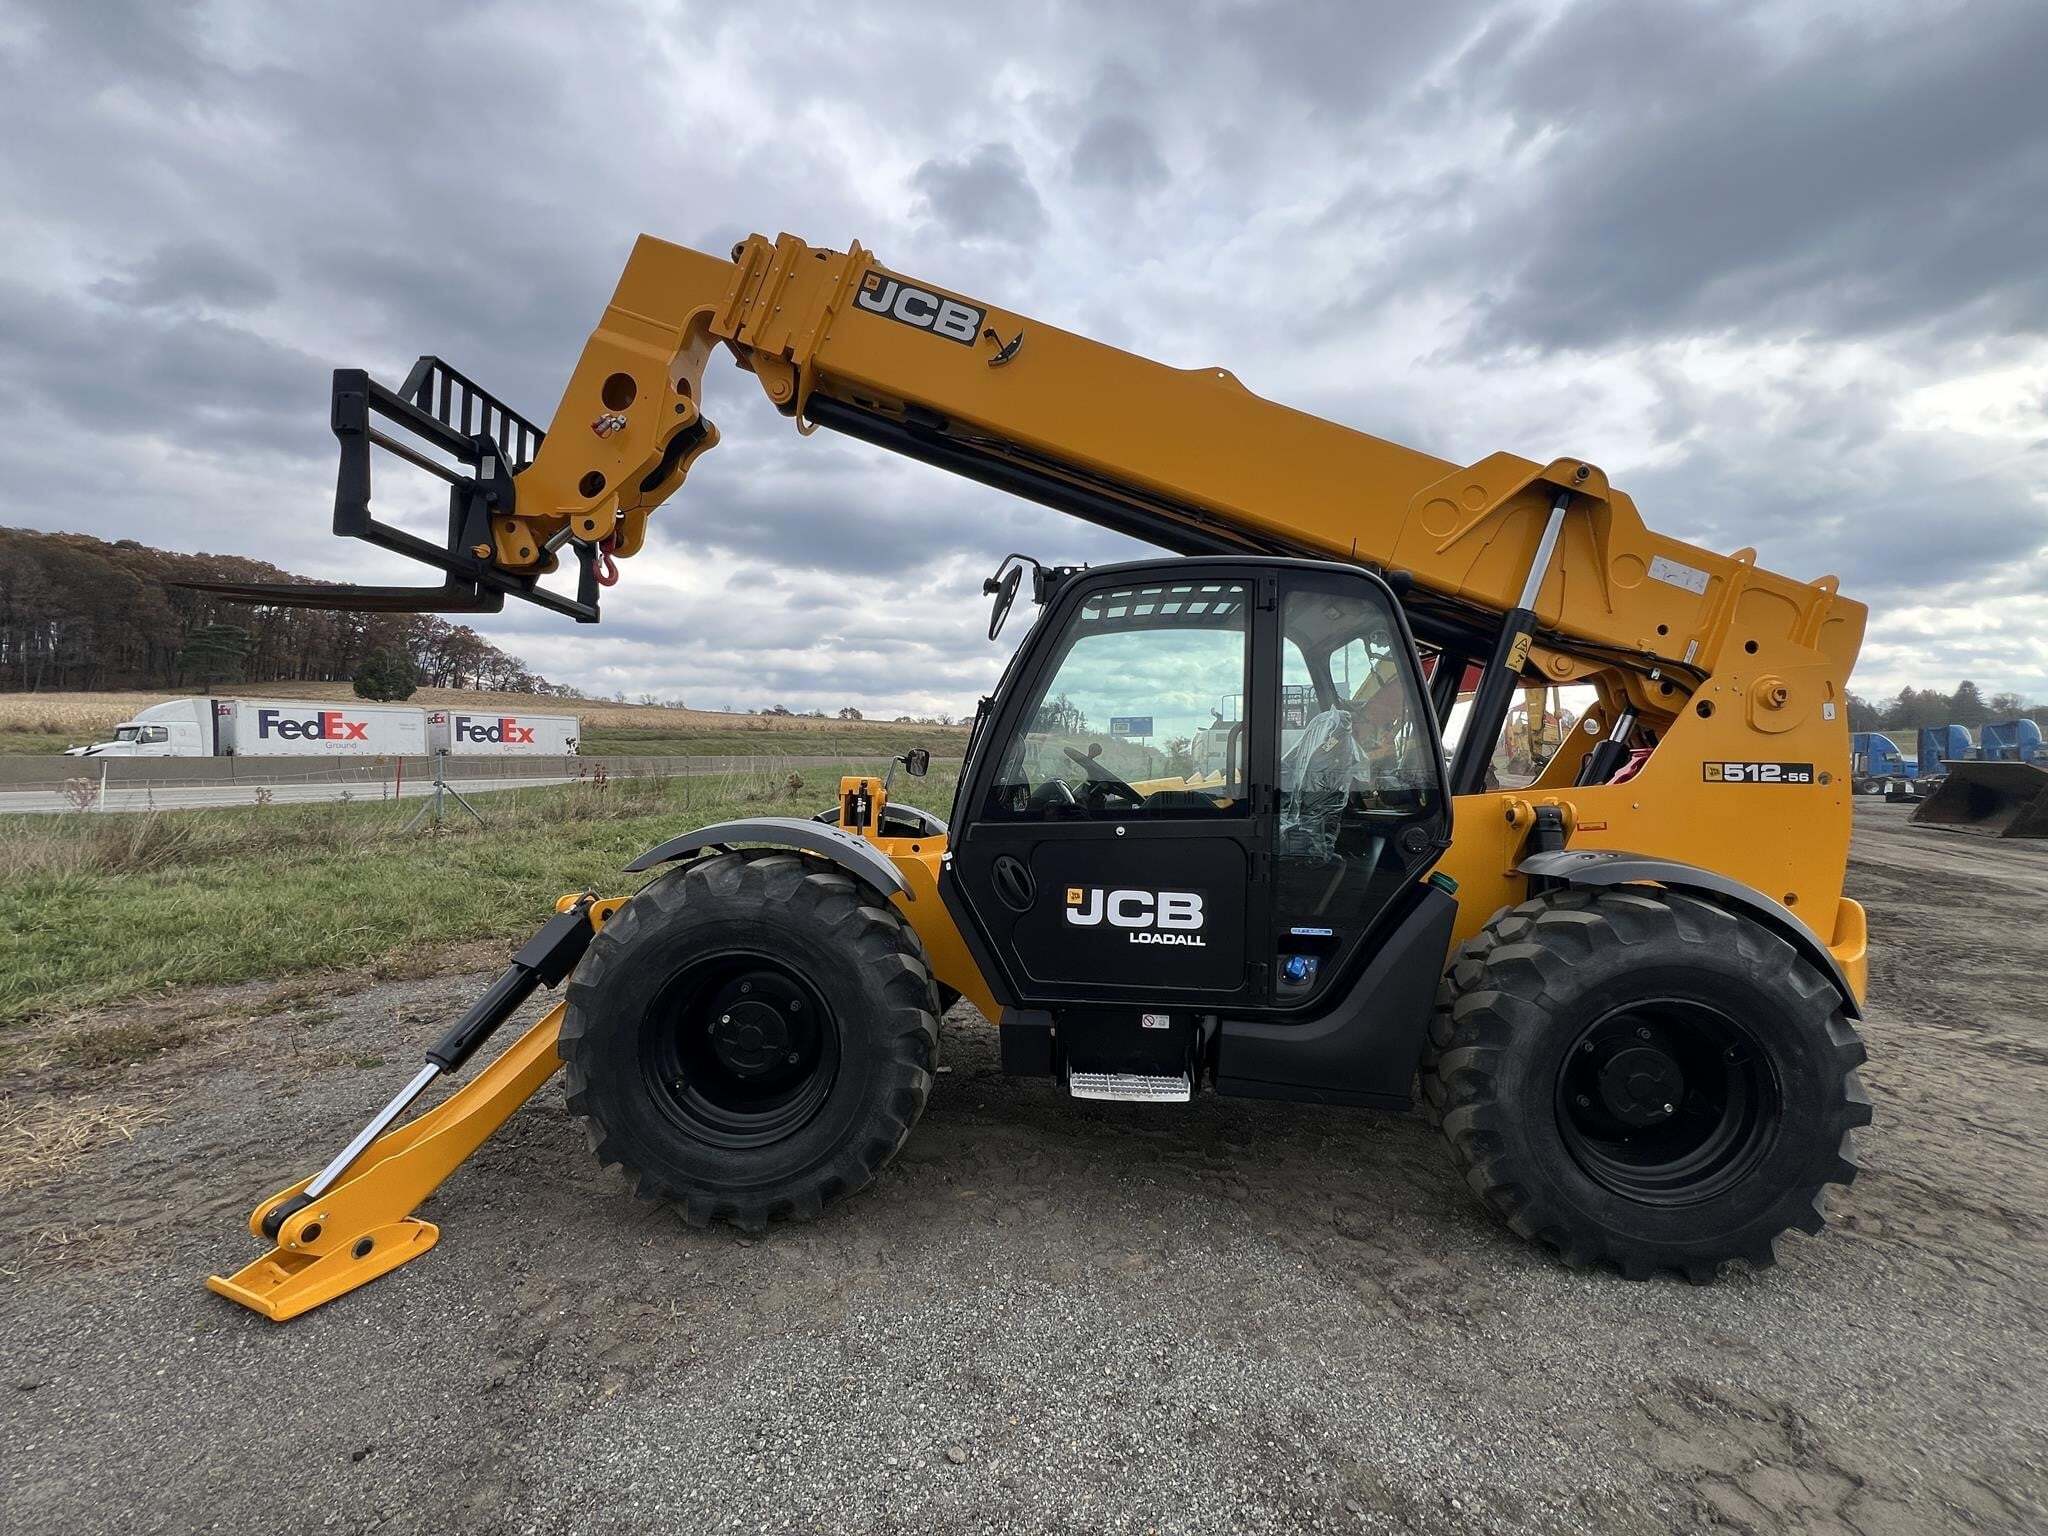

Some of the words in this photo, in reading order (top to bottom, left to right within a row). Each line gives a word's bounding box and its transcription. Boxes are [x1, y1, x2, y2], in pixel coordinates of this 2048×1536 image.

[859, 281, 980, 341] JCB
[258, 709, 369, 740] FedEx
[427, 713, 445, 725] edEx
[456, 716, 535, 743] FedEx
[1723, 763, 1810, 782] 512-56
[1066, 889, 1204, 929] JCB
[1129, 932, 1206, 947] LOADALL
